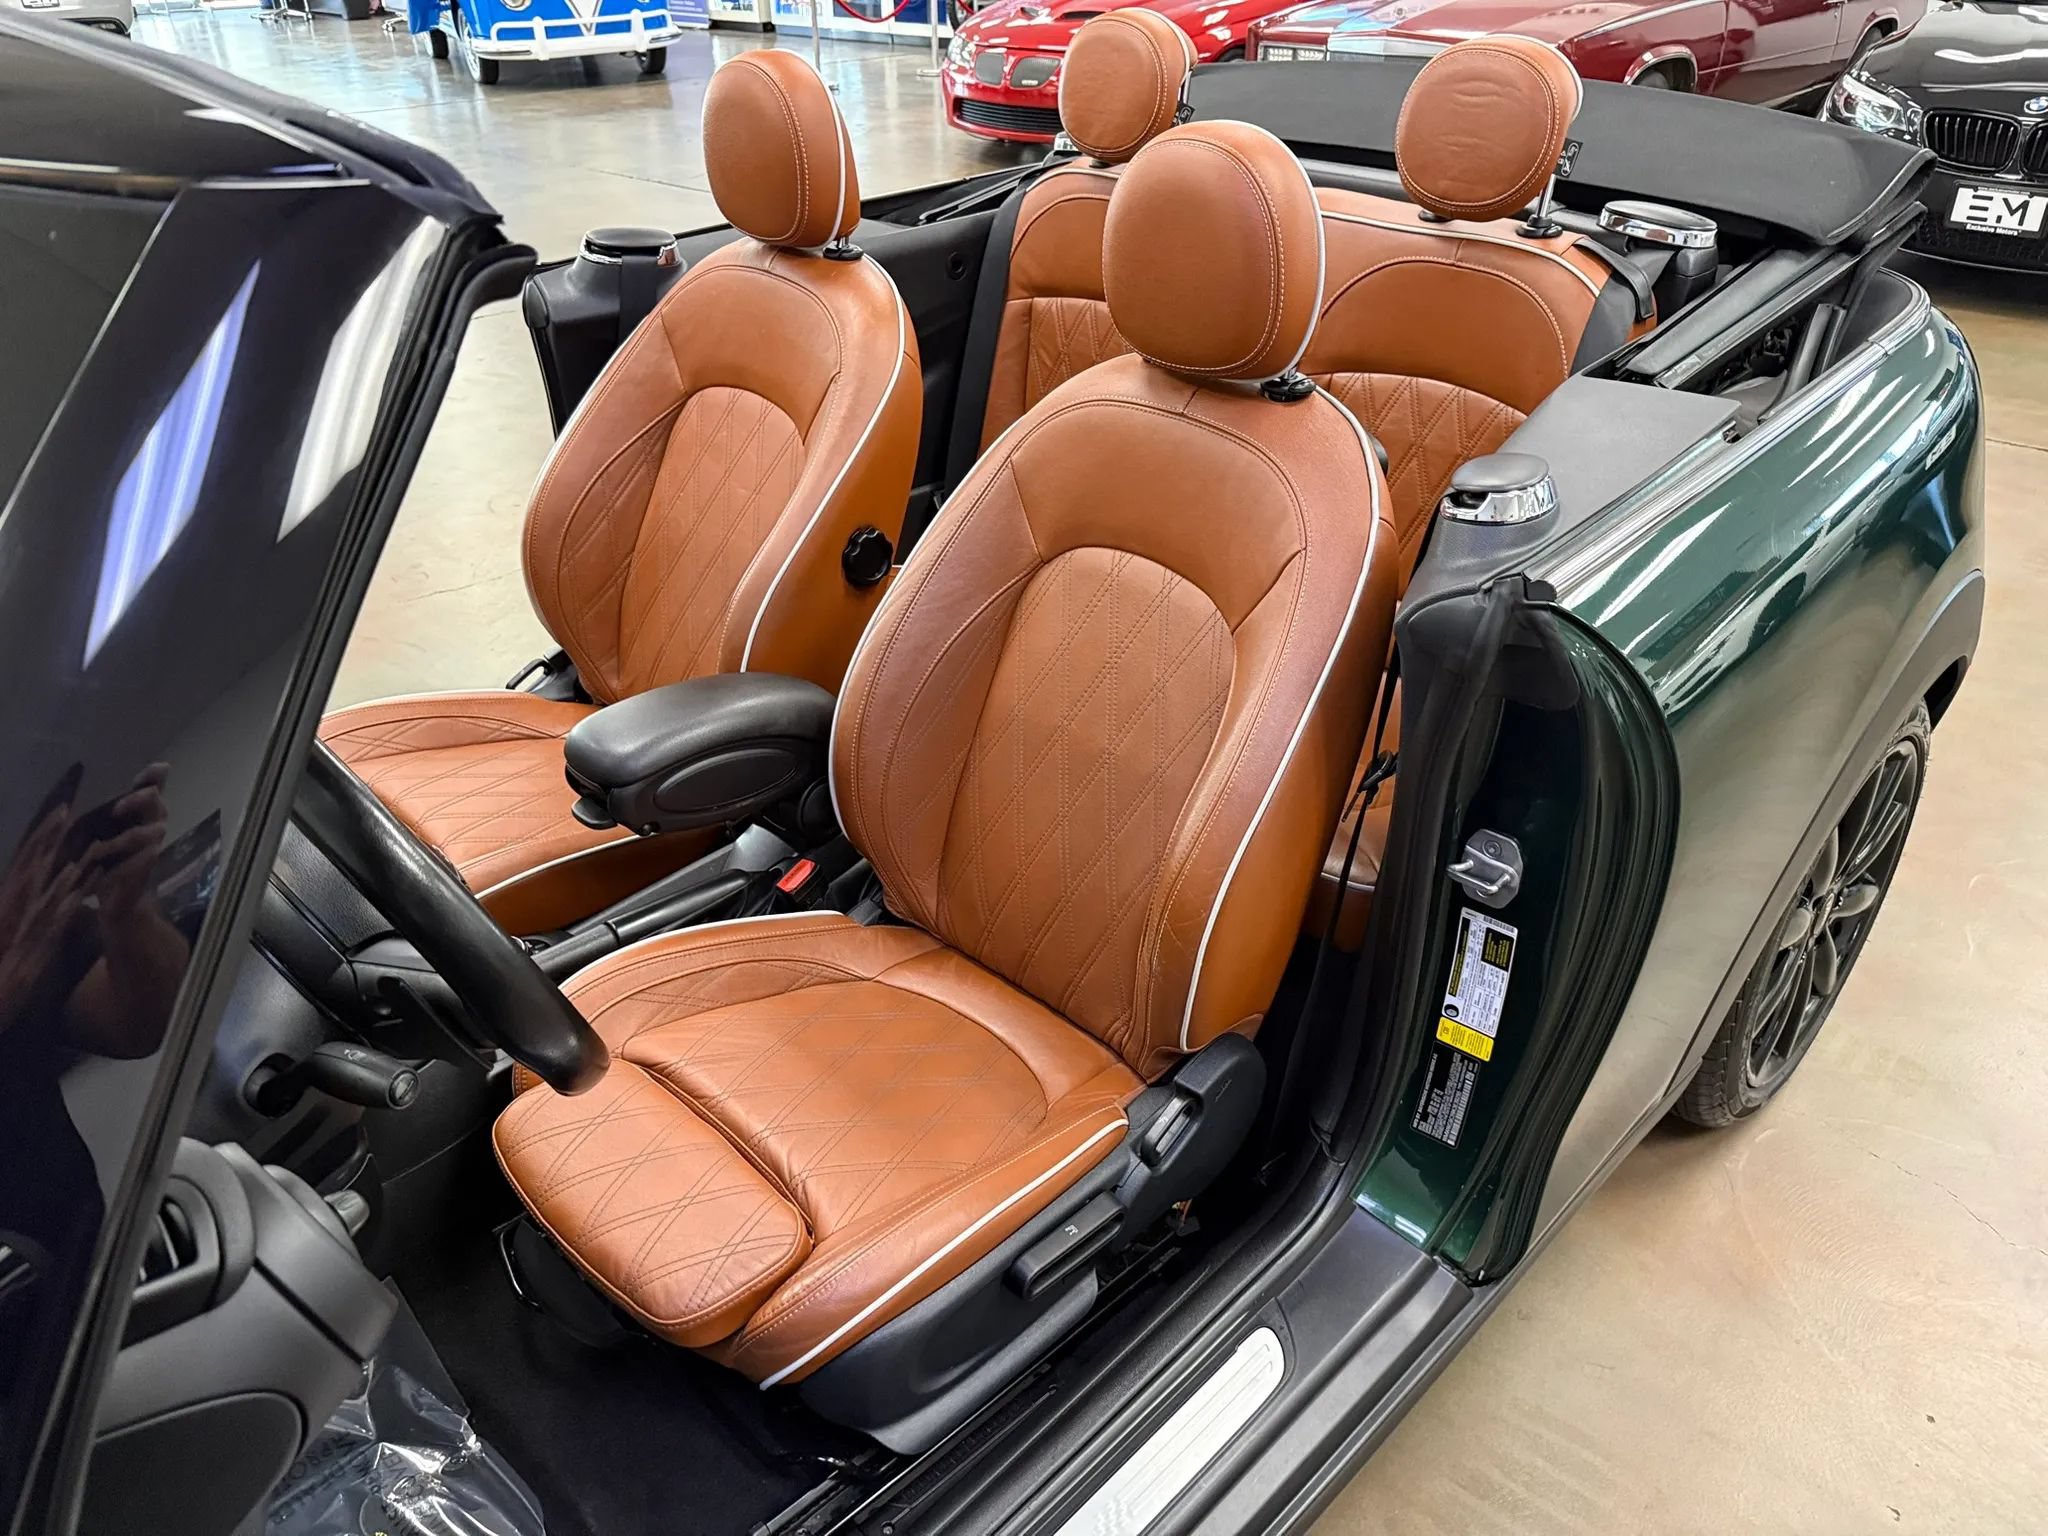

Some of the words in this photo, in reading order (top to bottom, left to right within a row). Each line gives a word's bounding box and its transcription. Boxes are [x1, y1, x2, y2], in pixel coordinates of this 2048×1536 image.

[1966, 194, 2030, 226] EM
[1966, 224, 1995, 232] Exclusive
[1996, 227, 2018, 236] Motors
